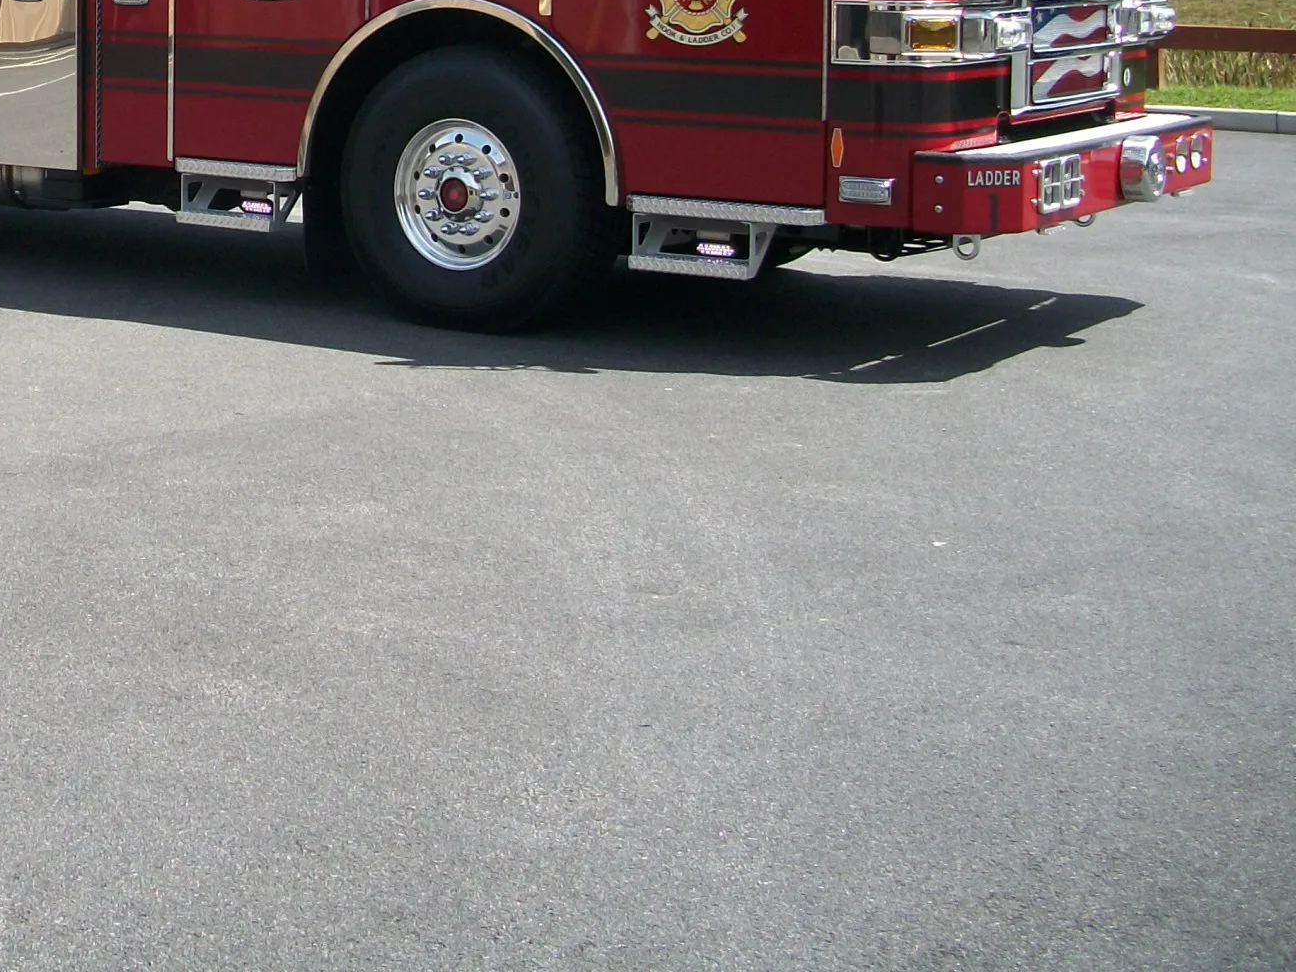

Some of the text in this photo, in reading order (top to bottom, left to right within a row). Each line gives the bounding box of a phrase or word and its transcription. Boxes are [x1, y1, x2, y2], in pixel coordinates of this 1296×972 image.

[656, 22, 677, 39] HOOK
[688, 34, 720, 43] LADDER
[967, 170, 1021, 187] LADDER
[989, 192, 999, 230] 1
